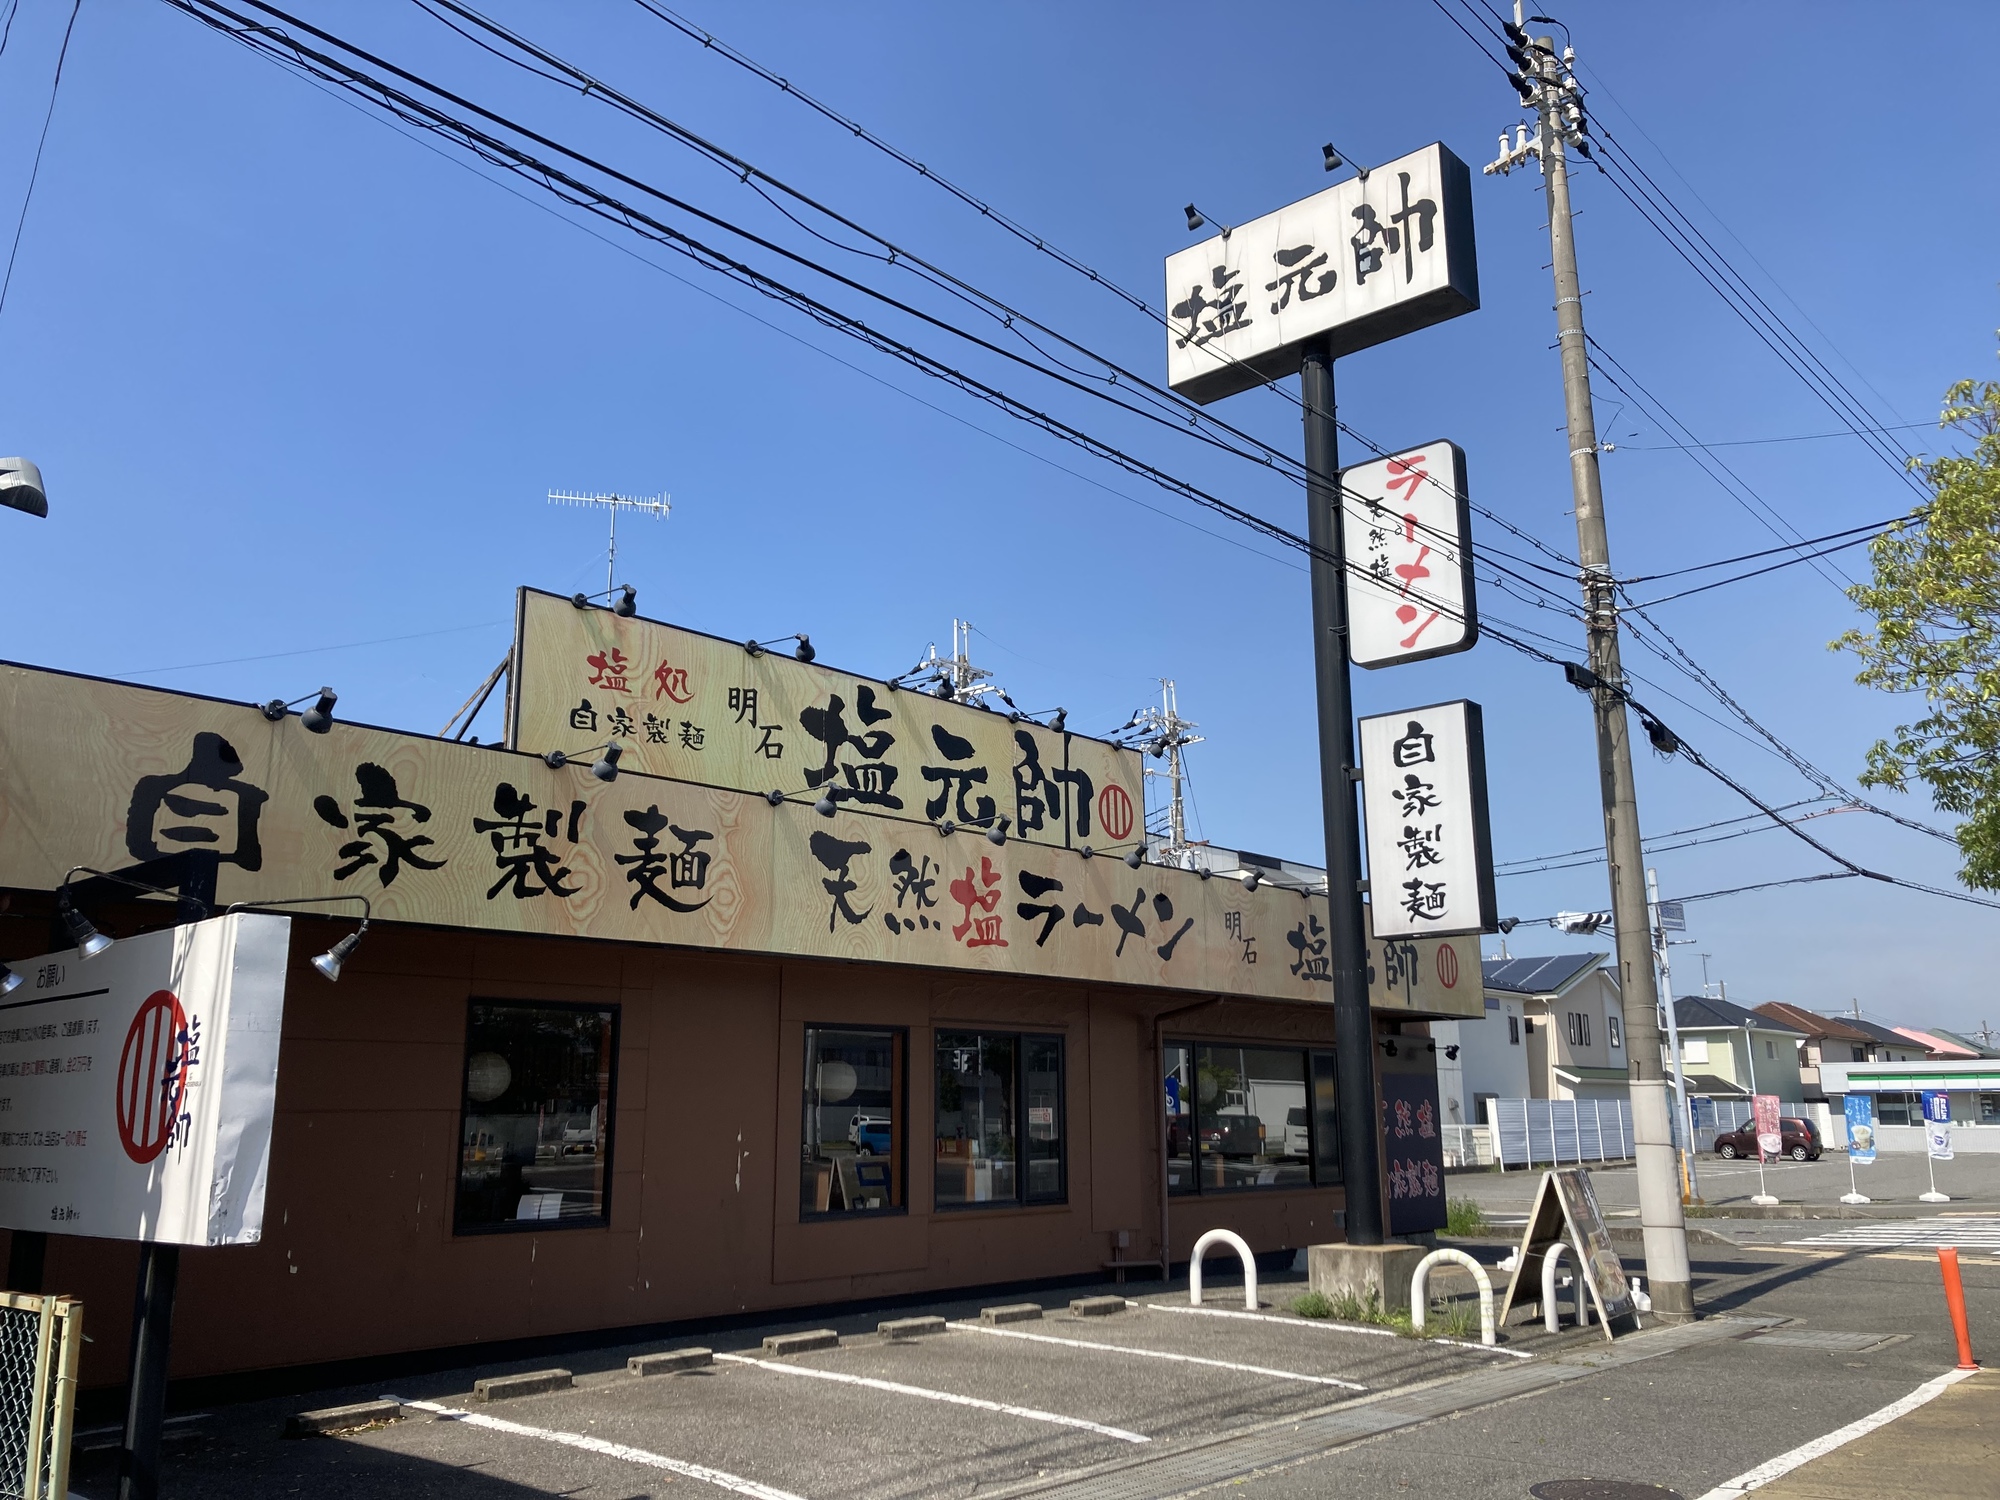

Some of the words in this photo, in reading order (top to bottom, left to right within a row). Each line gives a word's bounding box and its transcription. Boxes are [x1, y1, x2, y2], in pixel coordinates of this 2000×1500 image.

[1171, 171, 1438, 350] 塩元帥
[1366, 496, 1392, 580] 天然塩
[1385, 455, 1441, 649] ラーメン
[570, 698, 706, 752] 自家製麺
[587, 648, 695, 704] 塩処
[728, 686, 783, 760] 明石
[799, 684, 1094, 848] 塩元帥
[125, 731, 715, 914] 自家製麺
[1392, 720, 1449, 924] 自家製麺
[808, 830, 1194, 962] 天然塩ラーメン
[1223, 909, 1257, 966] 明石
[36, 963, 65, 989] お願い
